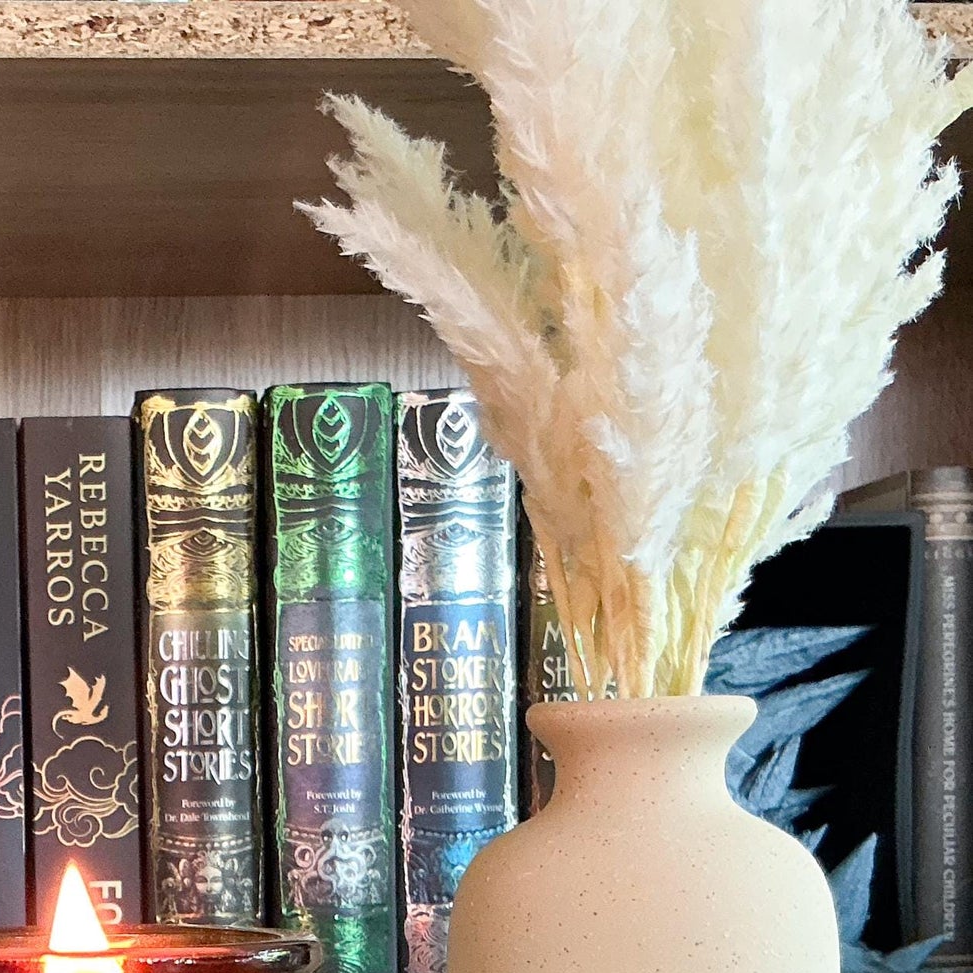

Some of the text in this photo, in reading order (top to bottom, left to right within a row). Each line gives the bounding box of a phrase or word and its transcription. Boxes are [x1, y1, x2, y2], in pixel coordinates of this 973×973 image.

[44, 467, 75, 626] YARROS
[78, 453, 109, 642] REBECCA
[158, 629, 250, 662] CHILLING
[413, 619, 501, 654] BRAM
[159, 664, 250, 706] GHOST
[411, 655, 502, 692] STOKER
[162, 706, 249, 749] SHORT
[413, 694, 501, 730] HORROR
[412, 730, 502, 765] STORIES
[942, 712, 956, 756] HOME
[162, 750, 252, 785] STORIES
[943, 760, 956, 790] FOR
[181, 797, 236, 809] Foreword by
[306, 790, 362, 803] Foreword by
[332, 804, 355, 814] Joshi
[430, 804, 473, 814] Catherine
[431, 789, 486, 801] Foreword by
[164, 813, 178, 822] Dr.
[180, 812, 200, 822] Dale
